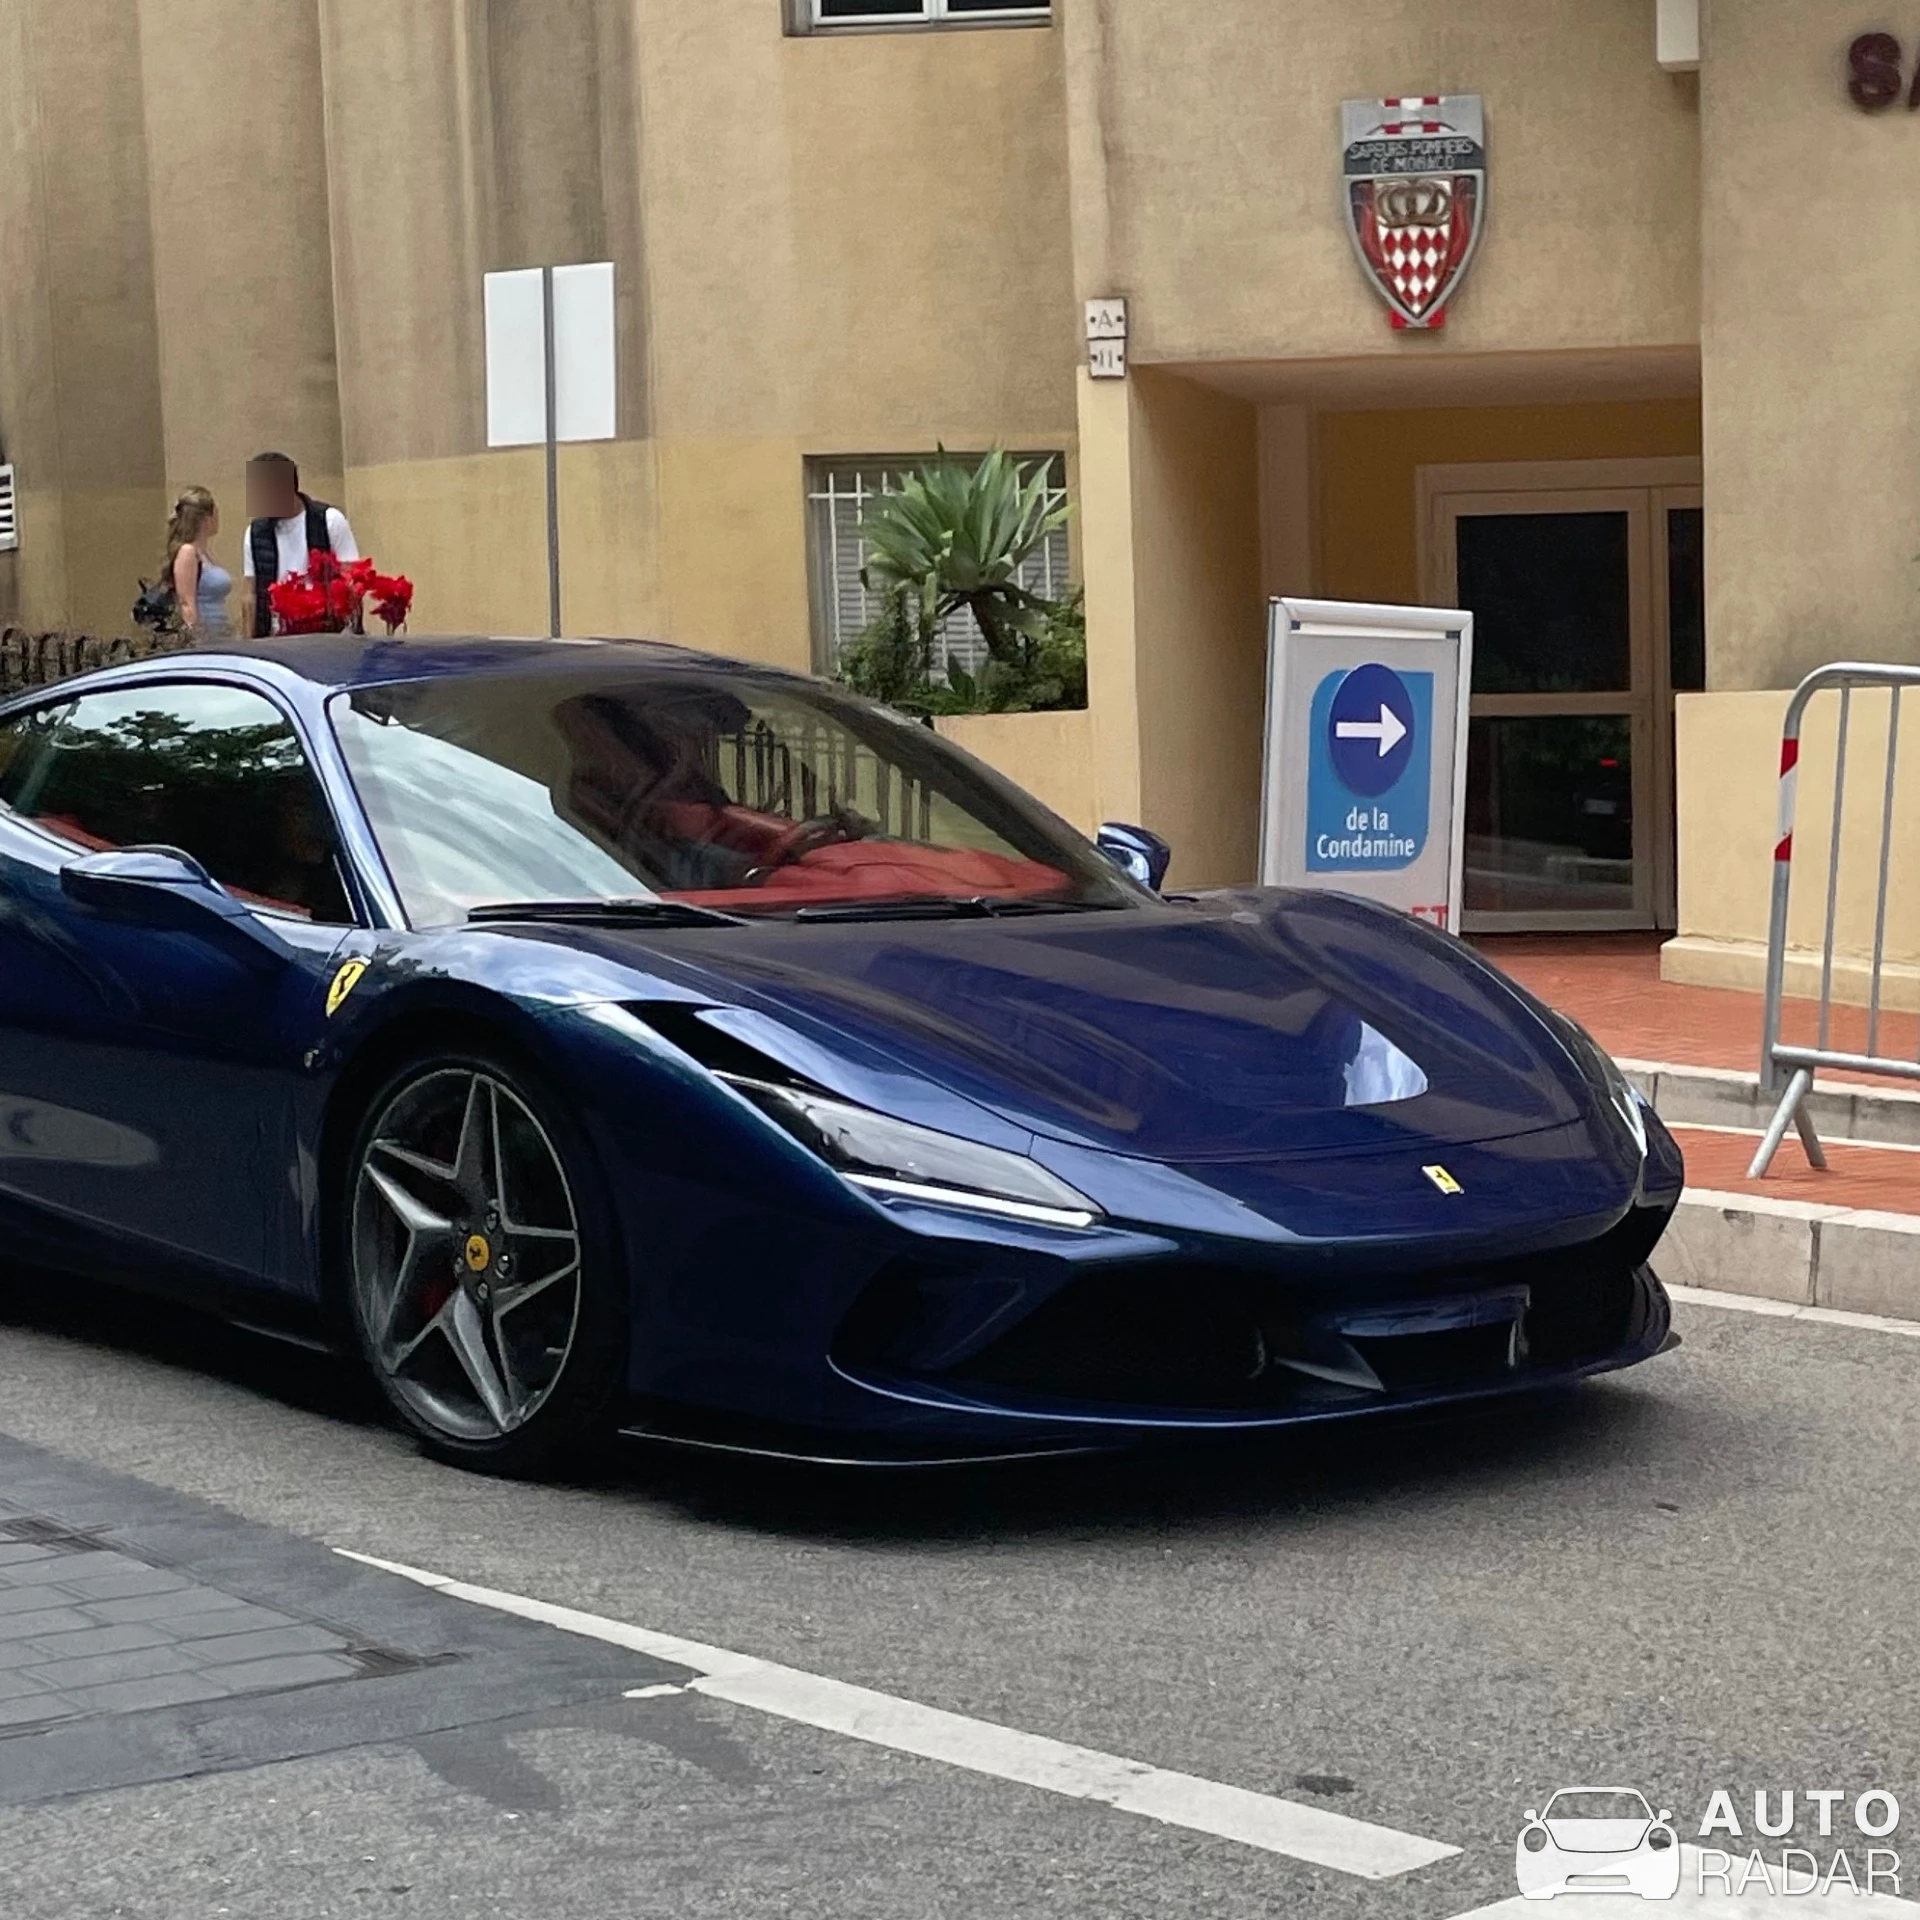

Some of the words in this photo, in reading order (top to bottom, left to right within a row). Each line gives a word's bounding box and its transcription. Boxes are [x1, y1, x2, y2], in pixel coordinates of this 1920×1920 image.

[1099, 309, 1112, 328] A
[1346, 806, 1369, 831] de
[1373, 806, 1389, 831] la
[1317, 833, 1416, 859] Condamine
